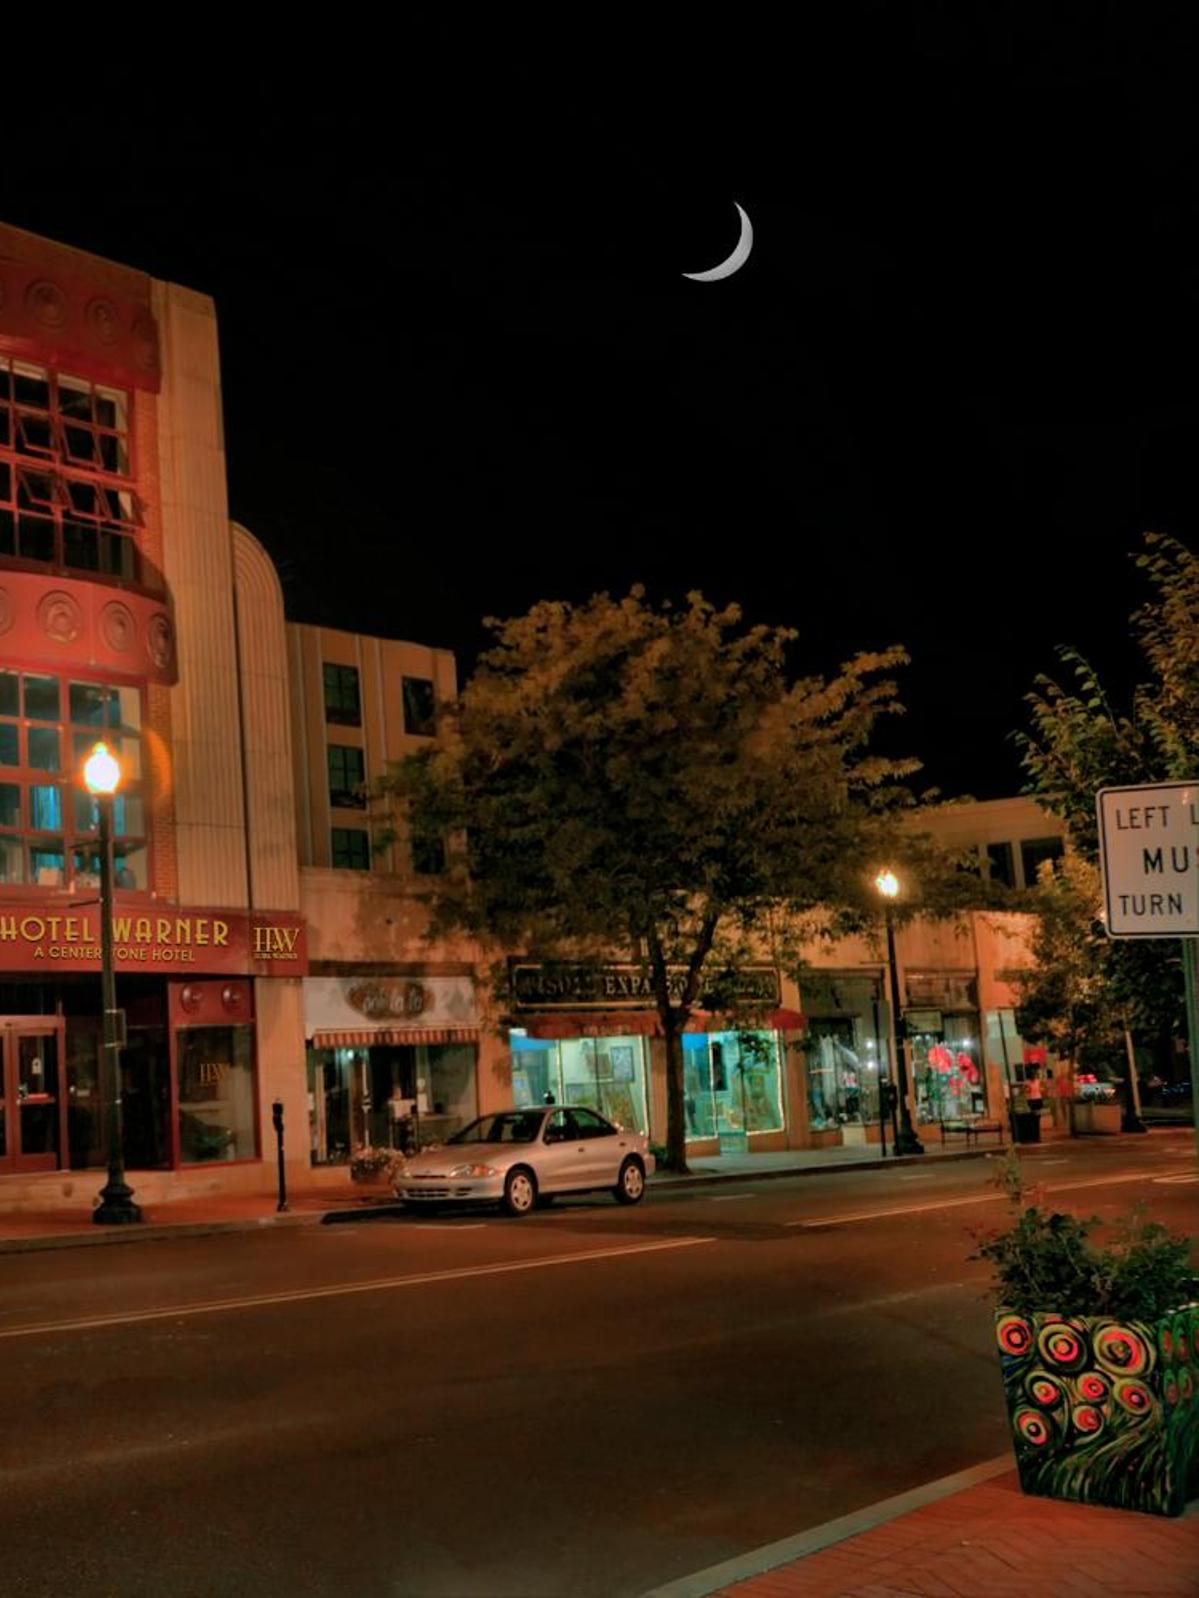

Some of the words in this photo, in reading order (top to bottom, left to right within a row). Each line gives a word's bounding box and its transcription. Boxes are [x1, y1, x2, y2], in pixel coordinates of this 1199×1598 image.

[1116, 806, 1170, 830] LEFT
[1143, 846, 1199, 874] MU
[1118, 894, 1183, 916] TURN
[0, 916, 95, 942] HOTEL
[112, 917, 229, 946] WARNER
[34, 946, 44, 957] A
[48, 946, 147, 961] CENTERONE
[152, 949, 196, 962] HOTEL
